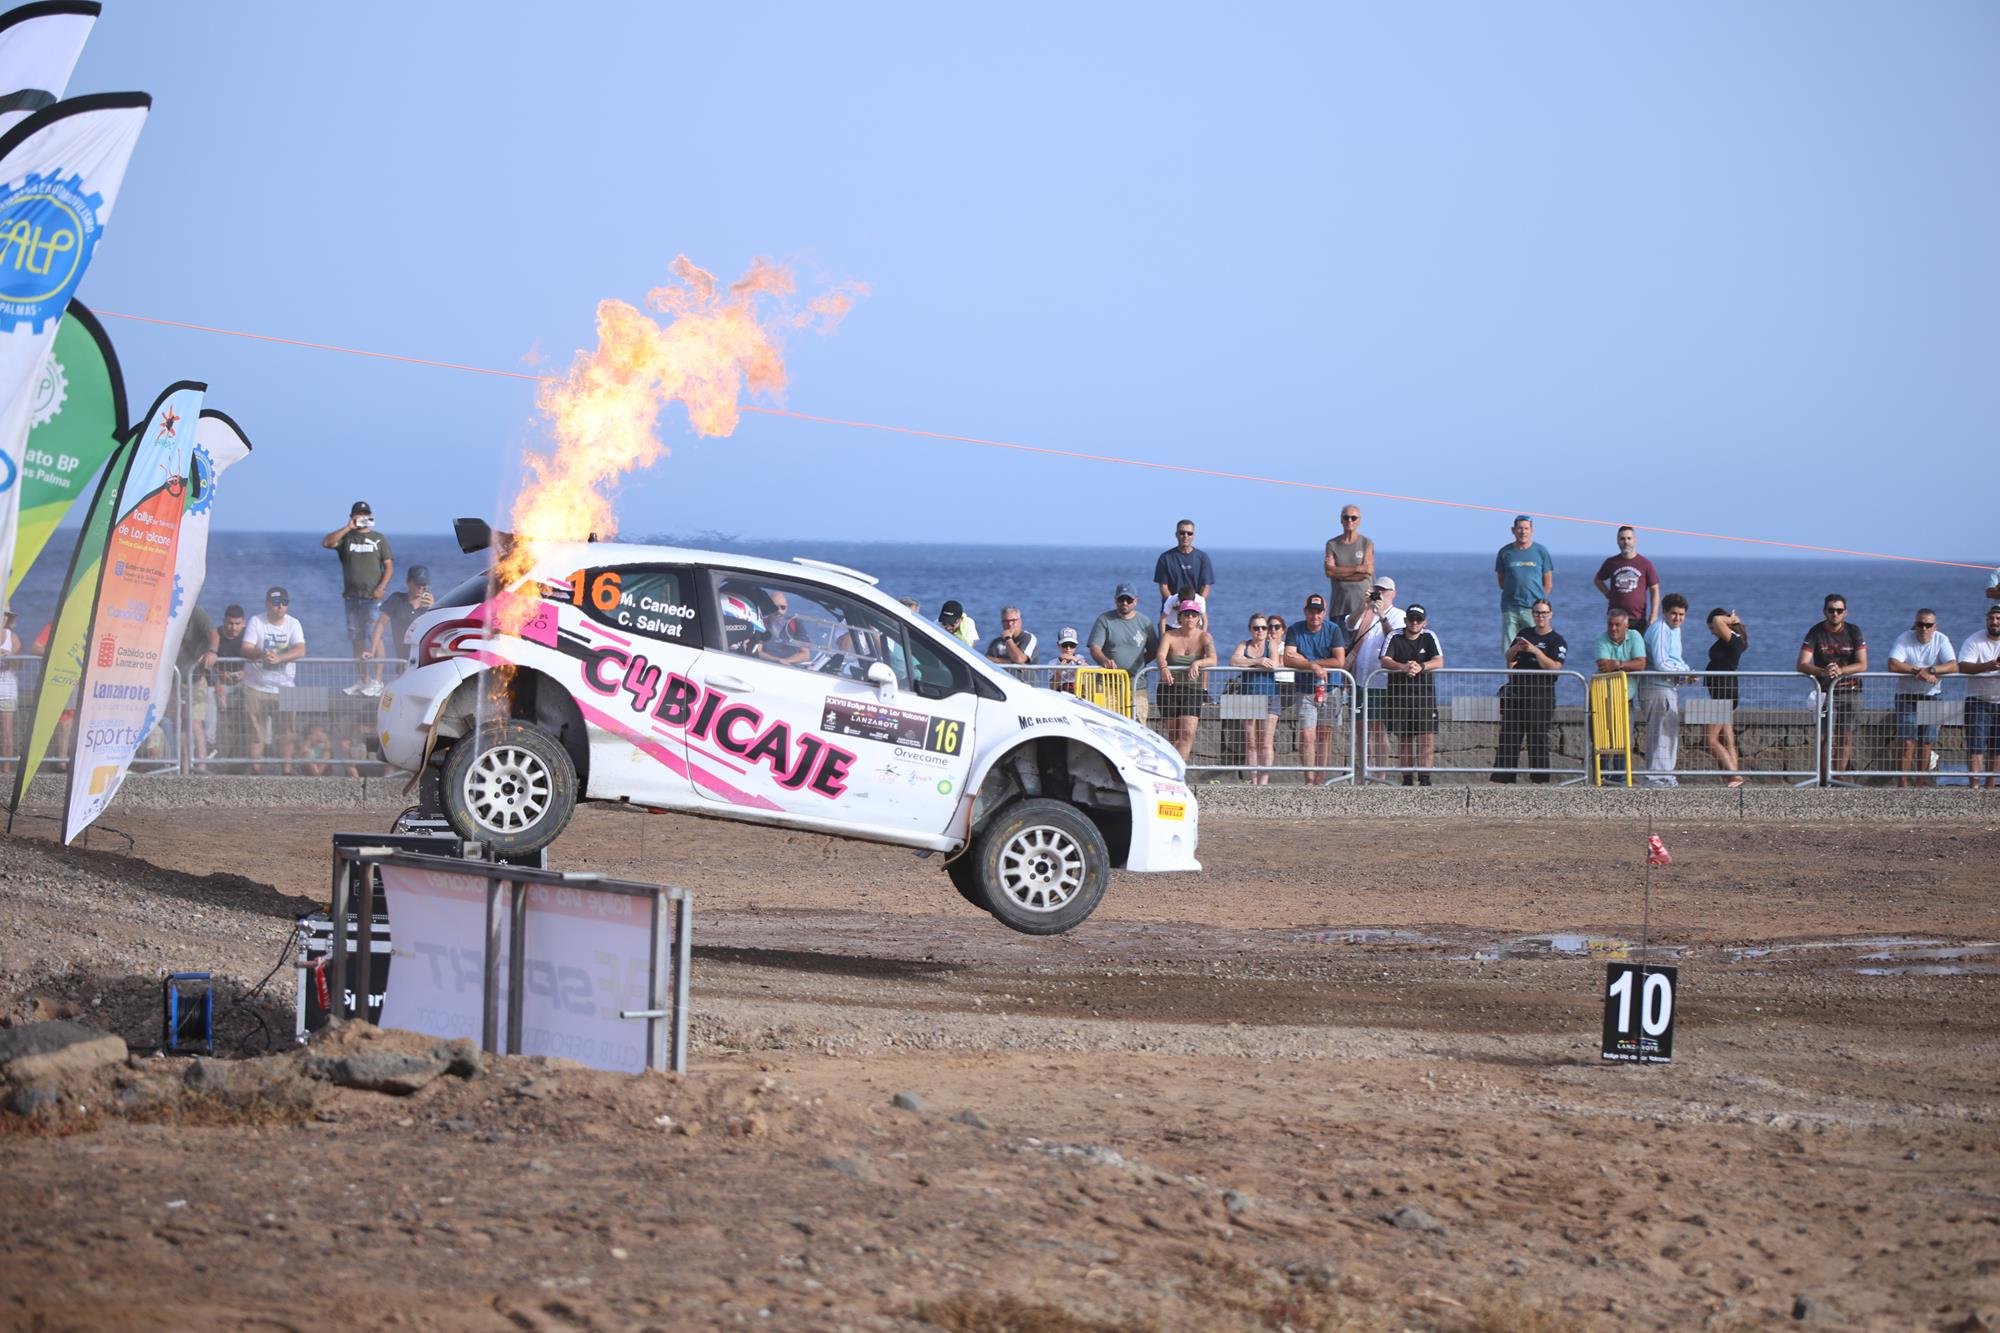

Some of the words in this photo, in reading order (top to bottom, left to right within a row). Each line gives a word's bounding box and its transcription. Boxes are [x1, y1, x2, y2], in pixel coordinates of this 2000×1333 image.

[57, 453, 80, 473] BP
[36, 468, 71, 488] Palmas
[119, 525, 129, 535] de
[565, 568, 622, 612] 16
[621, 592, 636, 608] M.
[640, 596, 696, 620] Canedo
[618, 611, 633, 627] C.
[636, 615, 683, 638] Salvat
[115, 657, 153, 670] Lanzarote
[145, 650, 158, 660] de
[93, 681, 151, 701] Lanzarote
[879, 706, 889, 715] de
[581, 646, 857, 799] C4BICAJE
[850, 715, 899, 730] LANZAROTE
[1018, 715, 1034, 730] MC
[1035, 715, 1071, 726] RACING
[935, 719, 959, 753] 16
[894, 747, 949, 766] Orvecame
[1159, 804, 1184, 817] PIRELLI
[1609, 970, 1672, 1036] 10
